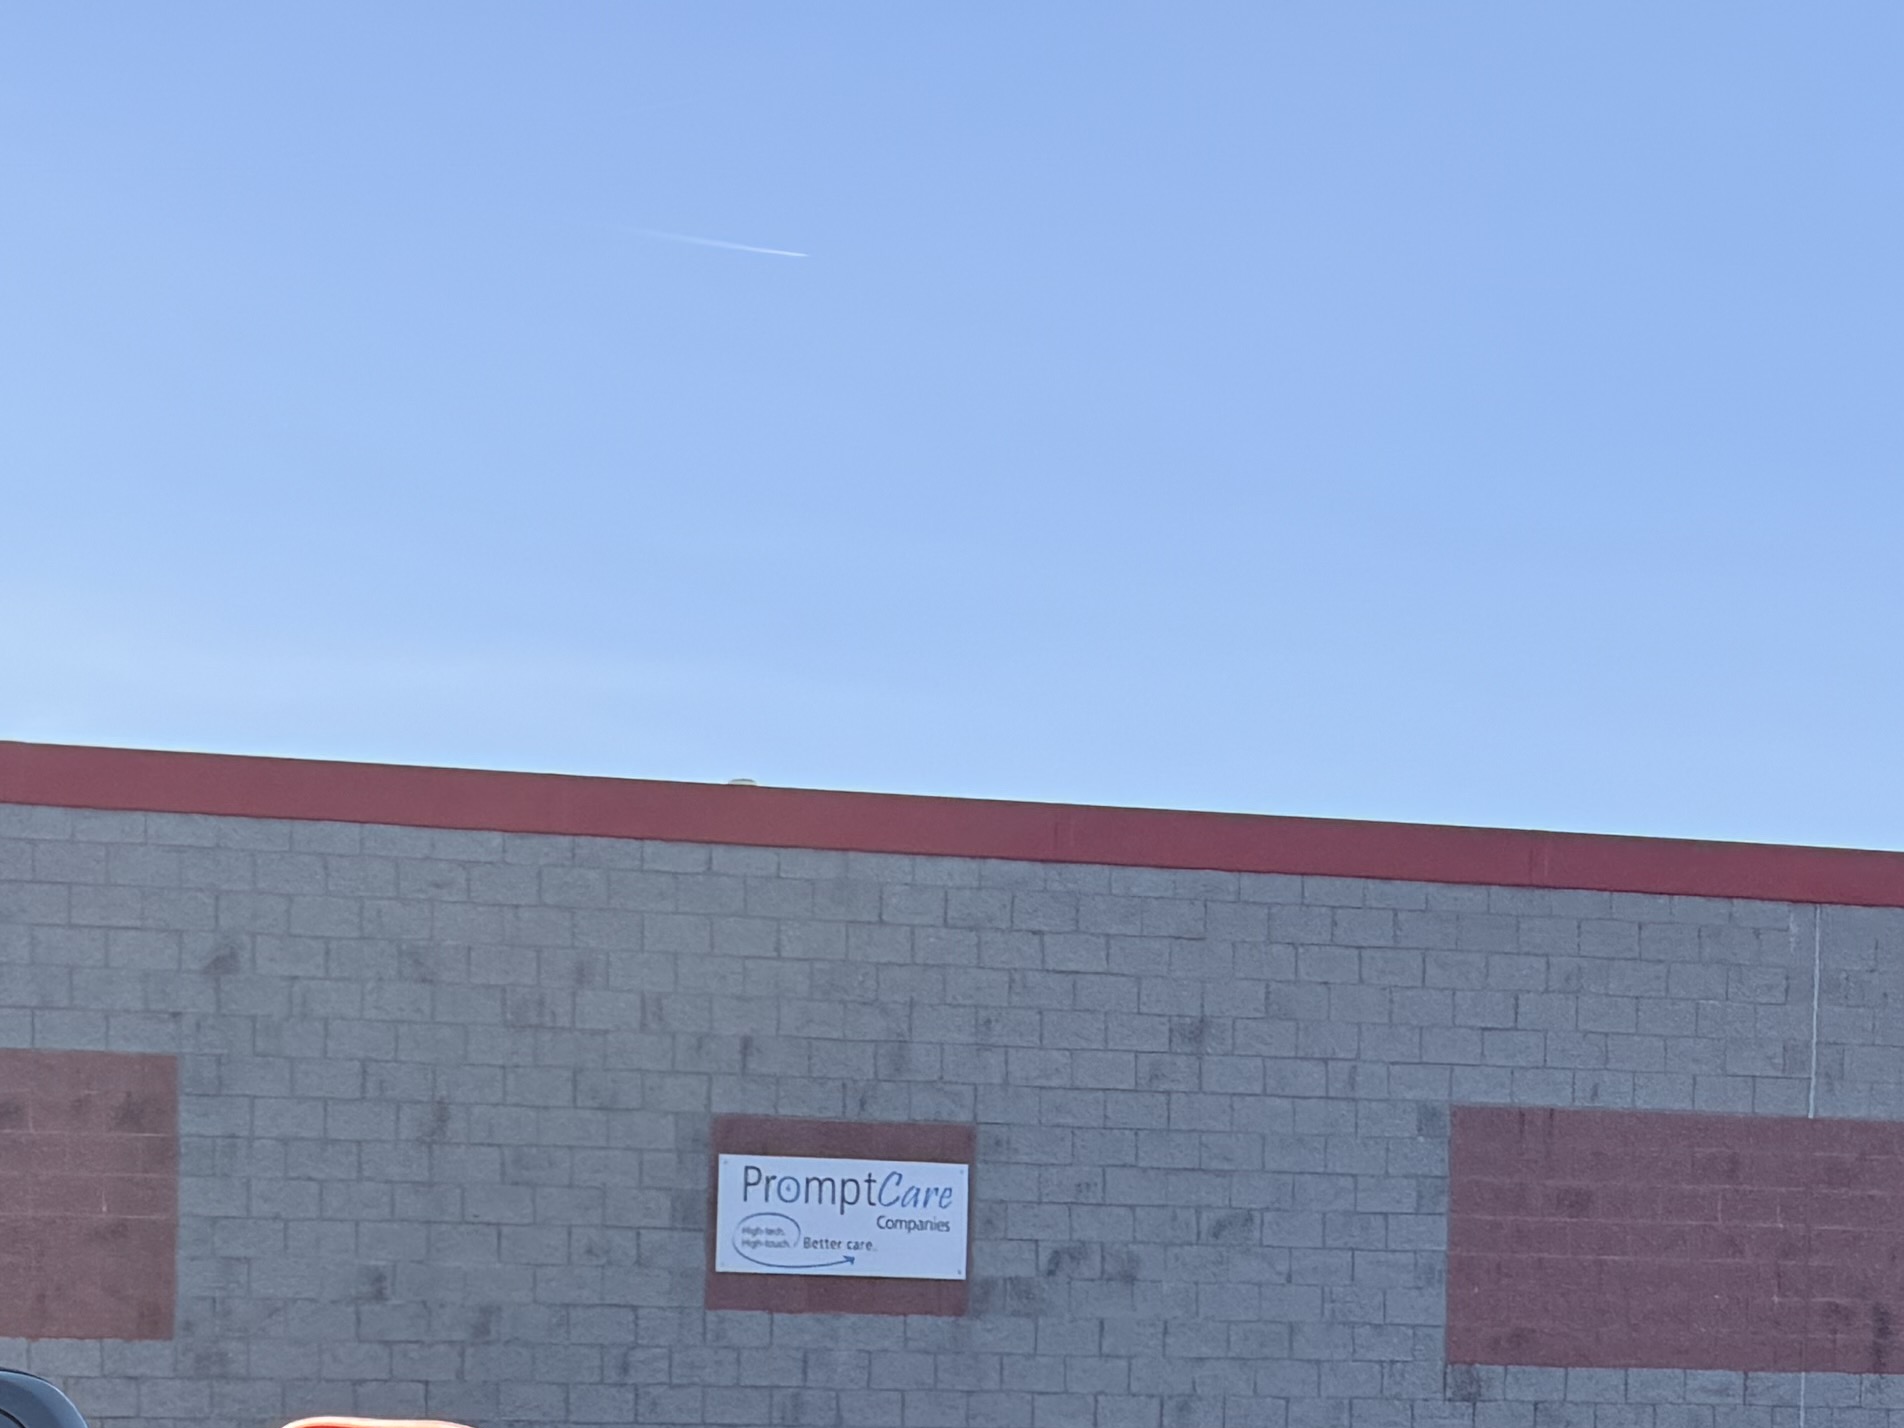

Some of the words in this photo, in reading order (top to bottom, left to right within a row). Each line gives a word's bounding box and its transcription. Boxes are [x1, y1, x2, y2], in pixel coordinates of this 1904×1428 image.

[742, 1164, 953, 1216] PromptCare
[875, 1214, 951, 1234] Companies
[803, 1236, 842, 1250] Better
